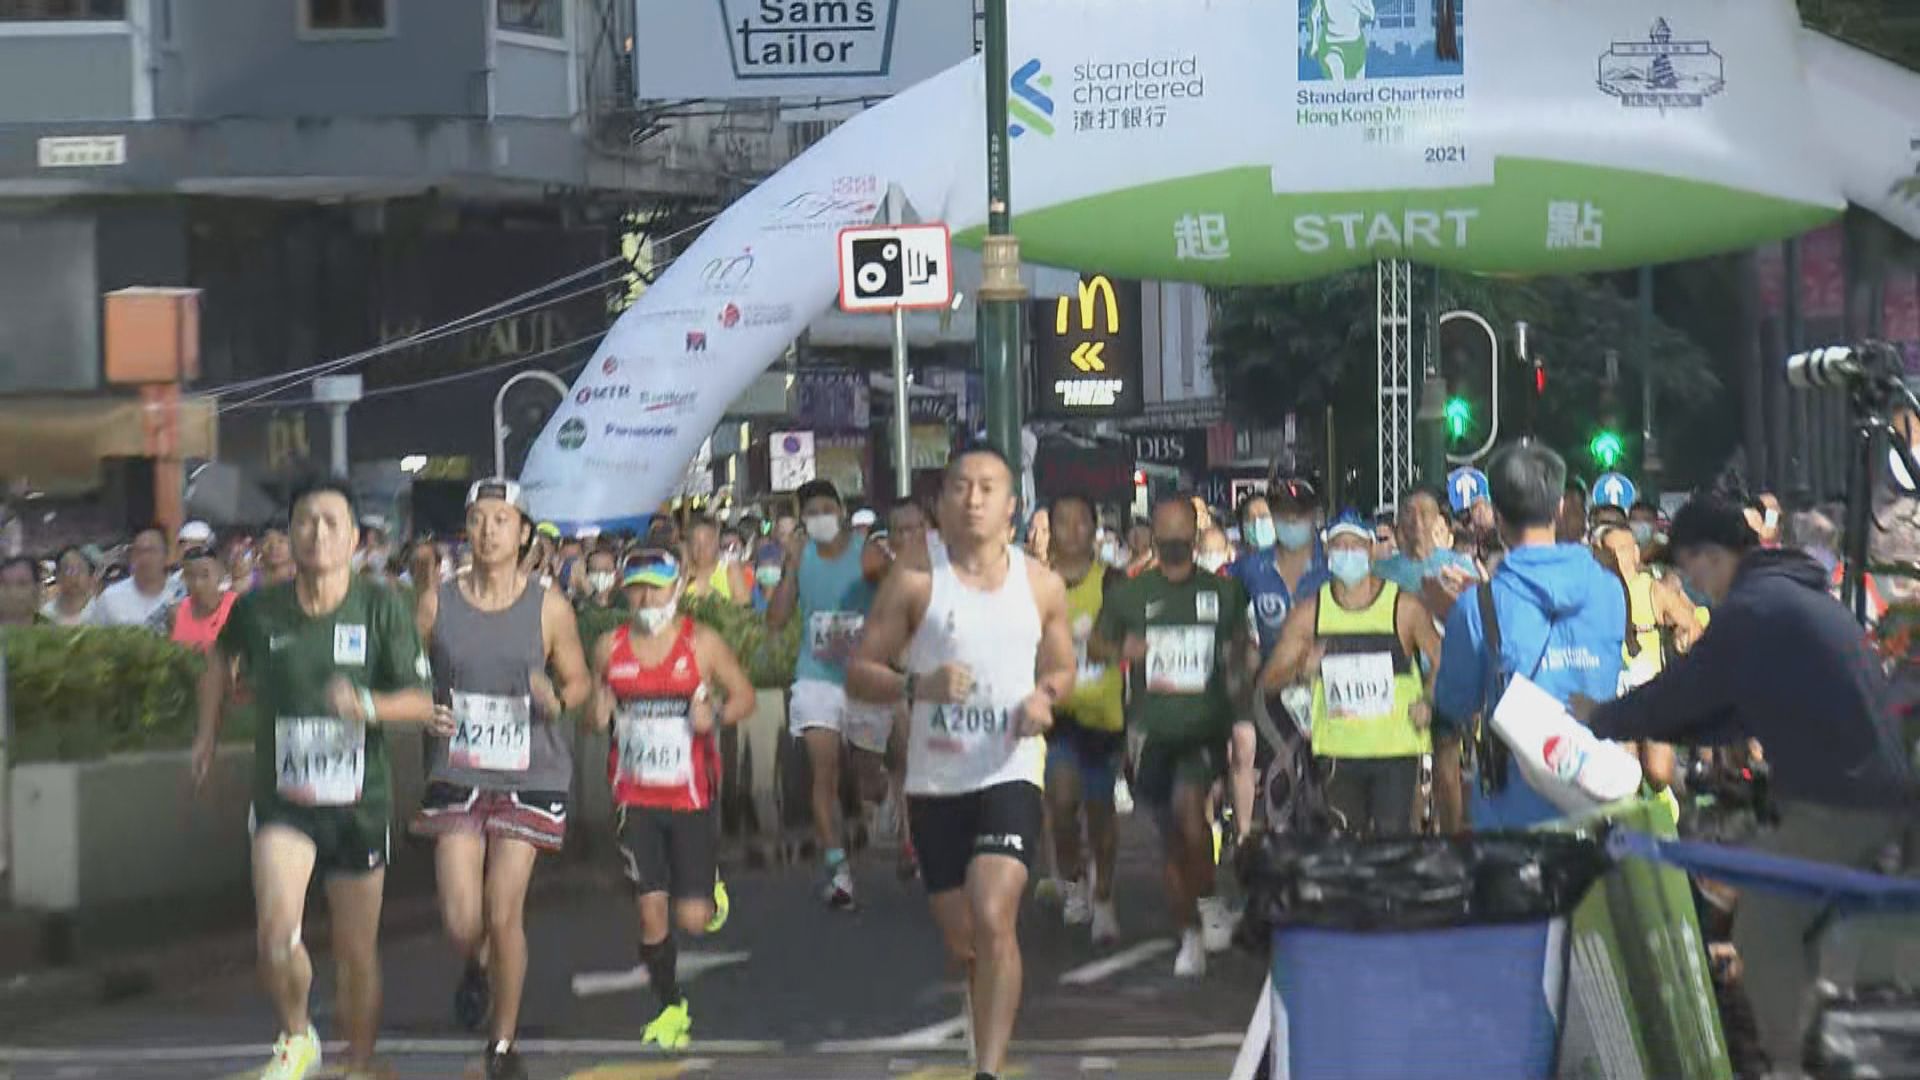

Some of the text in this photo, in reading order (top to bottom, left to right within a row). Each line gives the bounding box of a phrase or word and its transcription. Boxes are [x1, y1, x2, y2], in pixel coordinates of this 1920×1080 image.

[736, 18, 854, 65] tailor
[1073, 54, 1196, 81] standard
[1073, 75, 1204, 104] chartered
[1296, 84, 1465, 105] Standard Chartered
[1073, 105, 1168, 131] 渣打銀行
[1296, 108, 1338, 126] Hong
[1341, 107, 1383, 124] Kong
[1425, 146, 1466, 163] 2021
[1174, 201, 1604, 260] 起 START 點
[1135, 435, 1185, 461] DBS
[929, 704, 1009, 736] A2091
